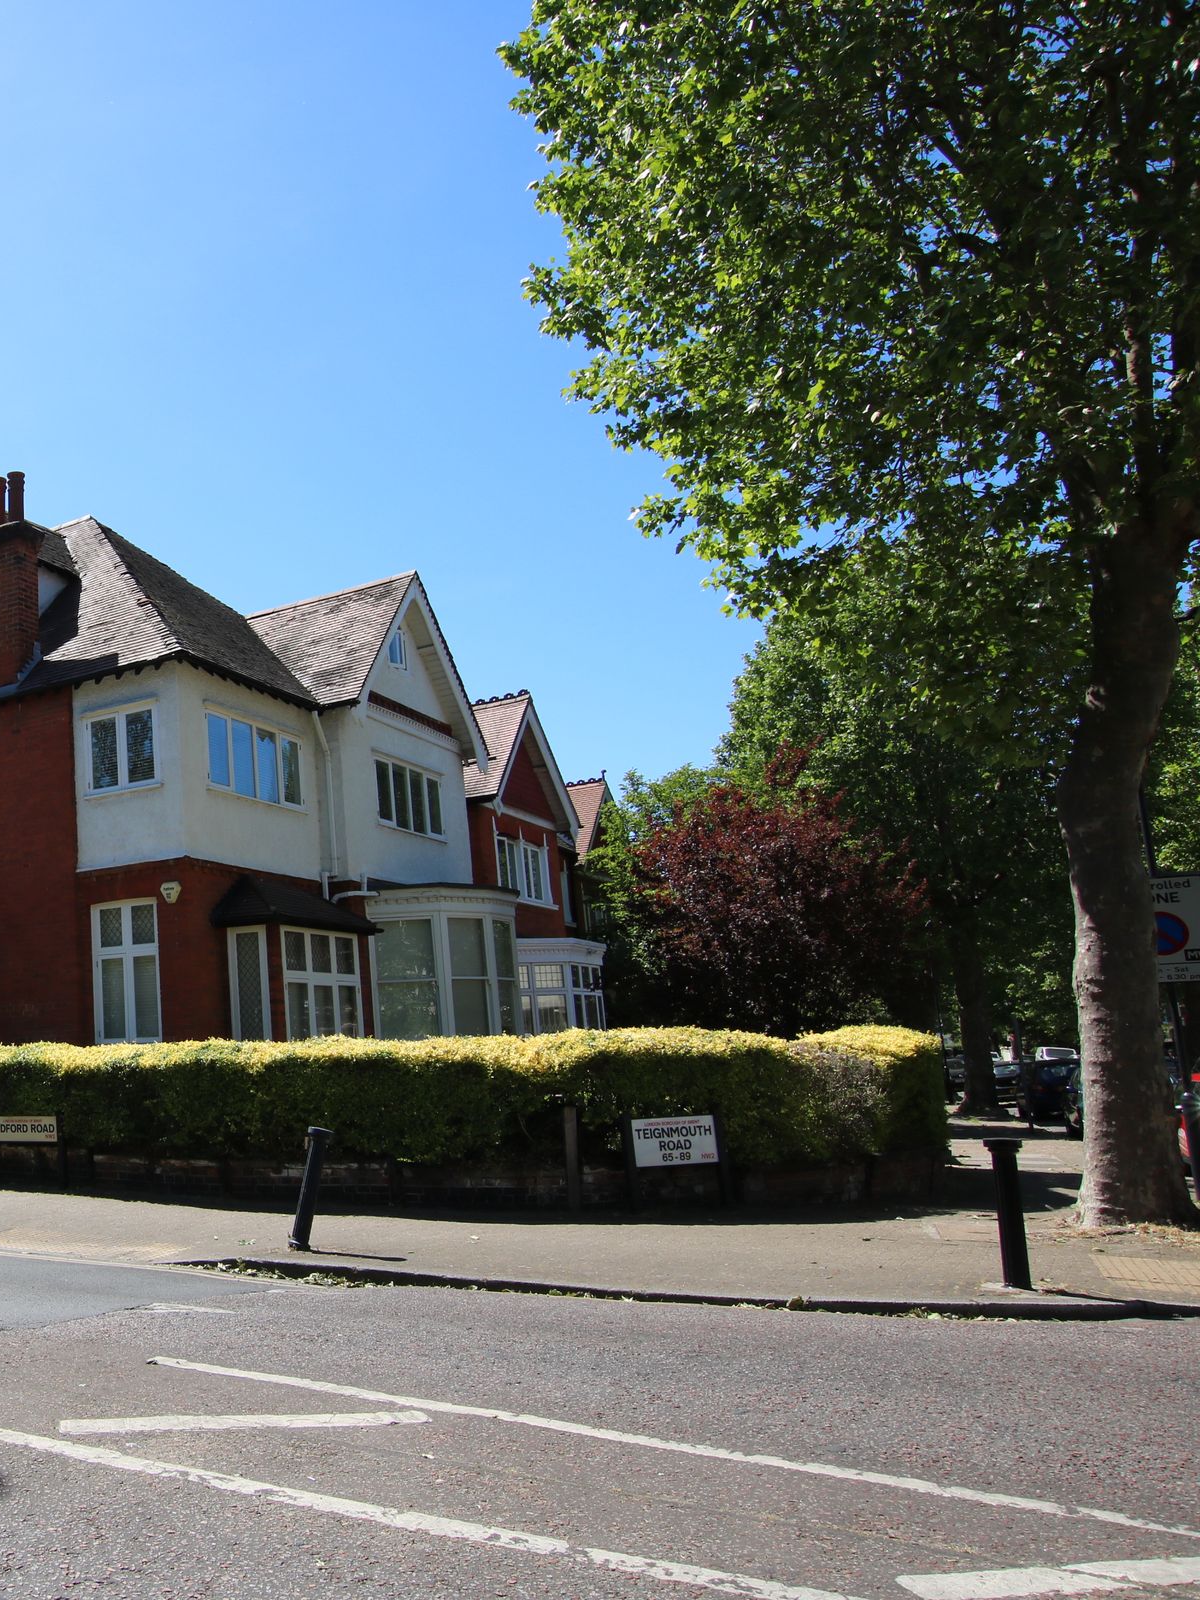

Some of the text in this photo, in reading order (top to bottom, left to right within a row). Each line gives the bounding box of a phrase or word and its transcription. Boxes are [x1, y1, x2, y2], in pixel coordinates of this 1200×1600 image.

[1152, 892, 1180, 903] NE
[30, 1123, 55, 1133] ROAD
[635, 1125, 712, 1139] TEIGNMOUTH
[659, 1139, 692, 1151] ROAD
[701, 1152, 715, 1160] NW2
